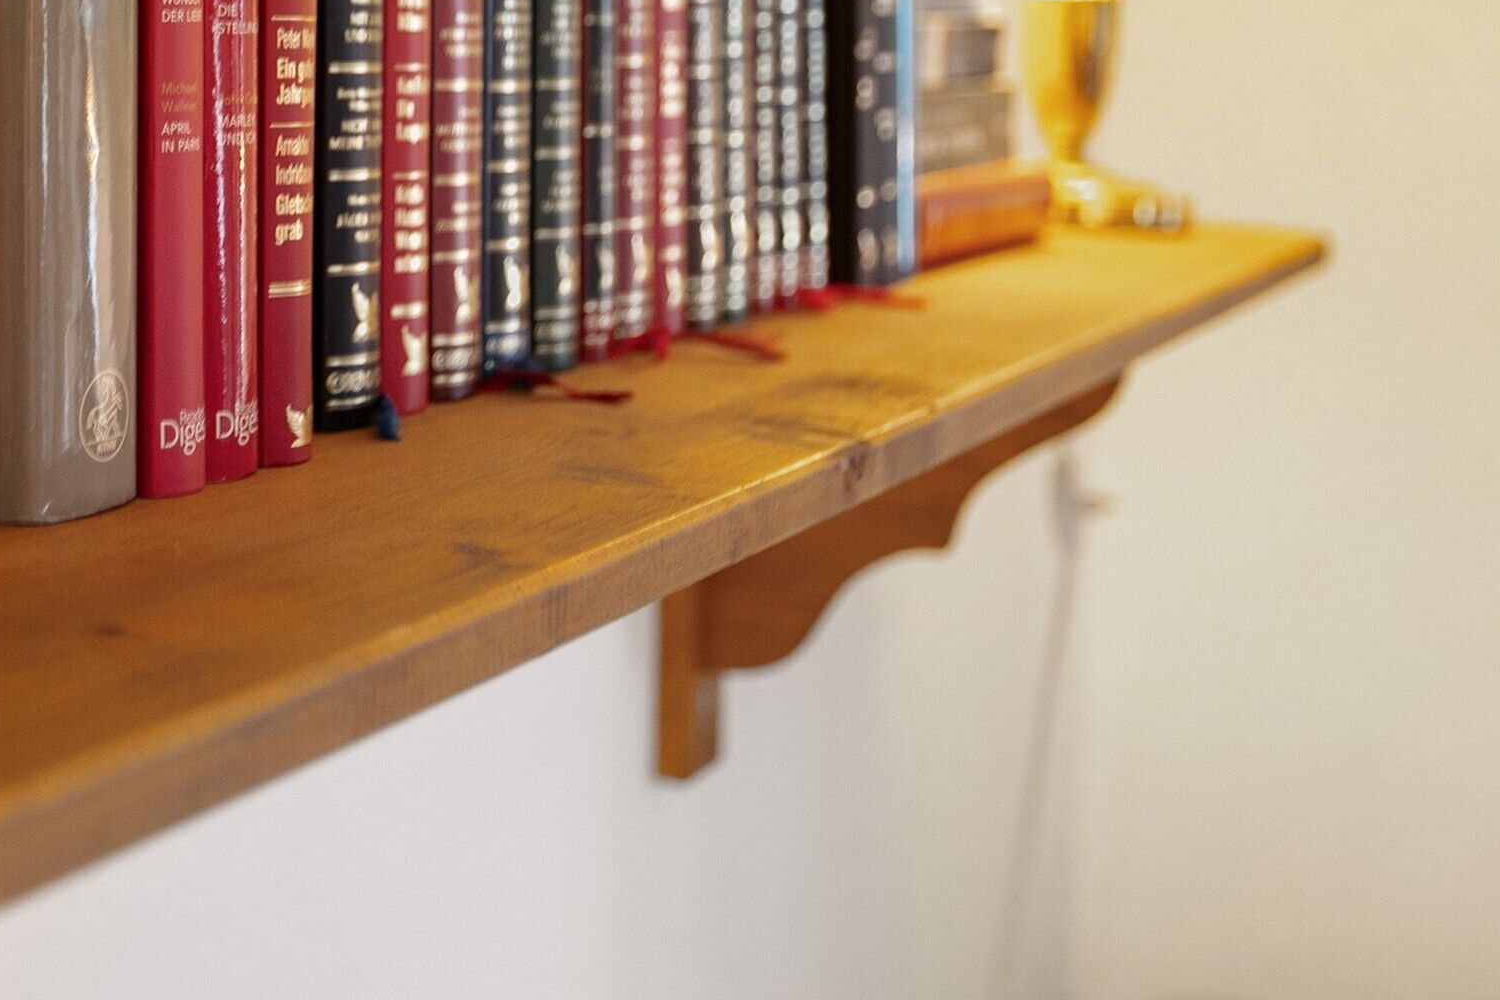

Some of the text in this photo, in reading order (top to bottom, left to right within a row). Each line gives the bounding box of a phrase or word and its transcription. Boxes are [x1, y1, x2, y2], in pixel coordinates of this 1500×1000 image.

[161, 9, 184, 23] DER
[218, 2, 238, 18] DIE
[276, 56, 296, 80] Ein
[161, 122, 191, 136] APRIL
[161, 139, 175, 153] IN
[274, 216, 304, 247] grab
